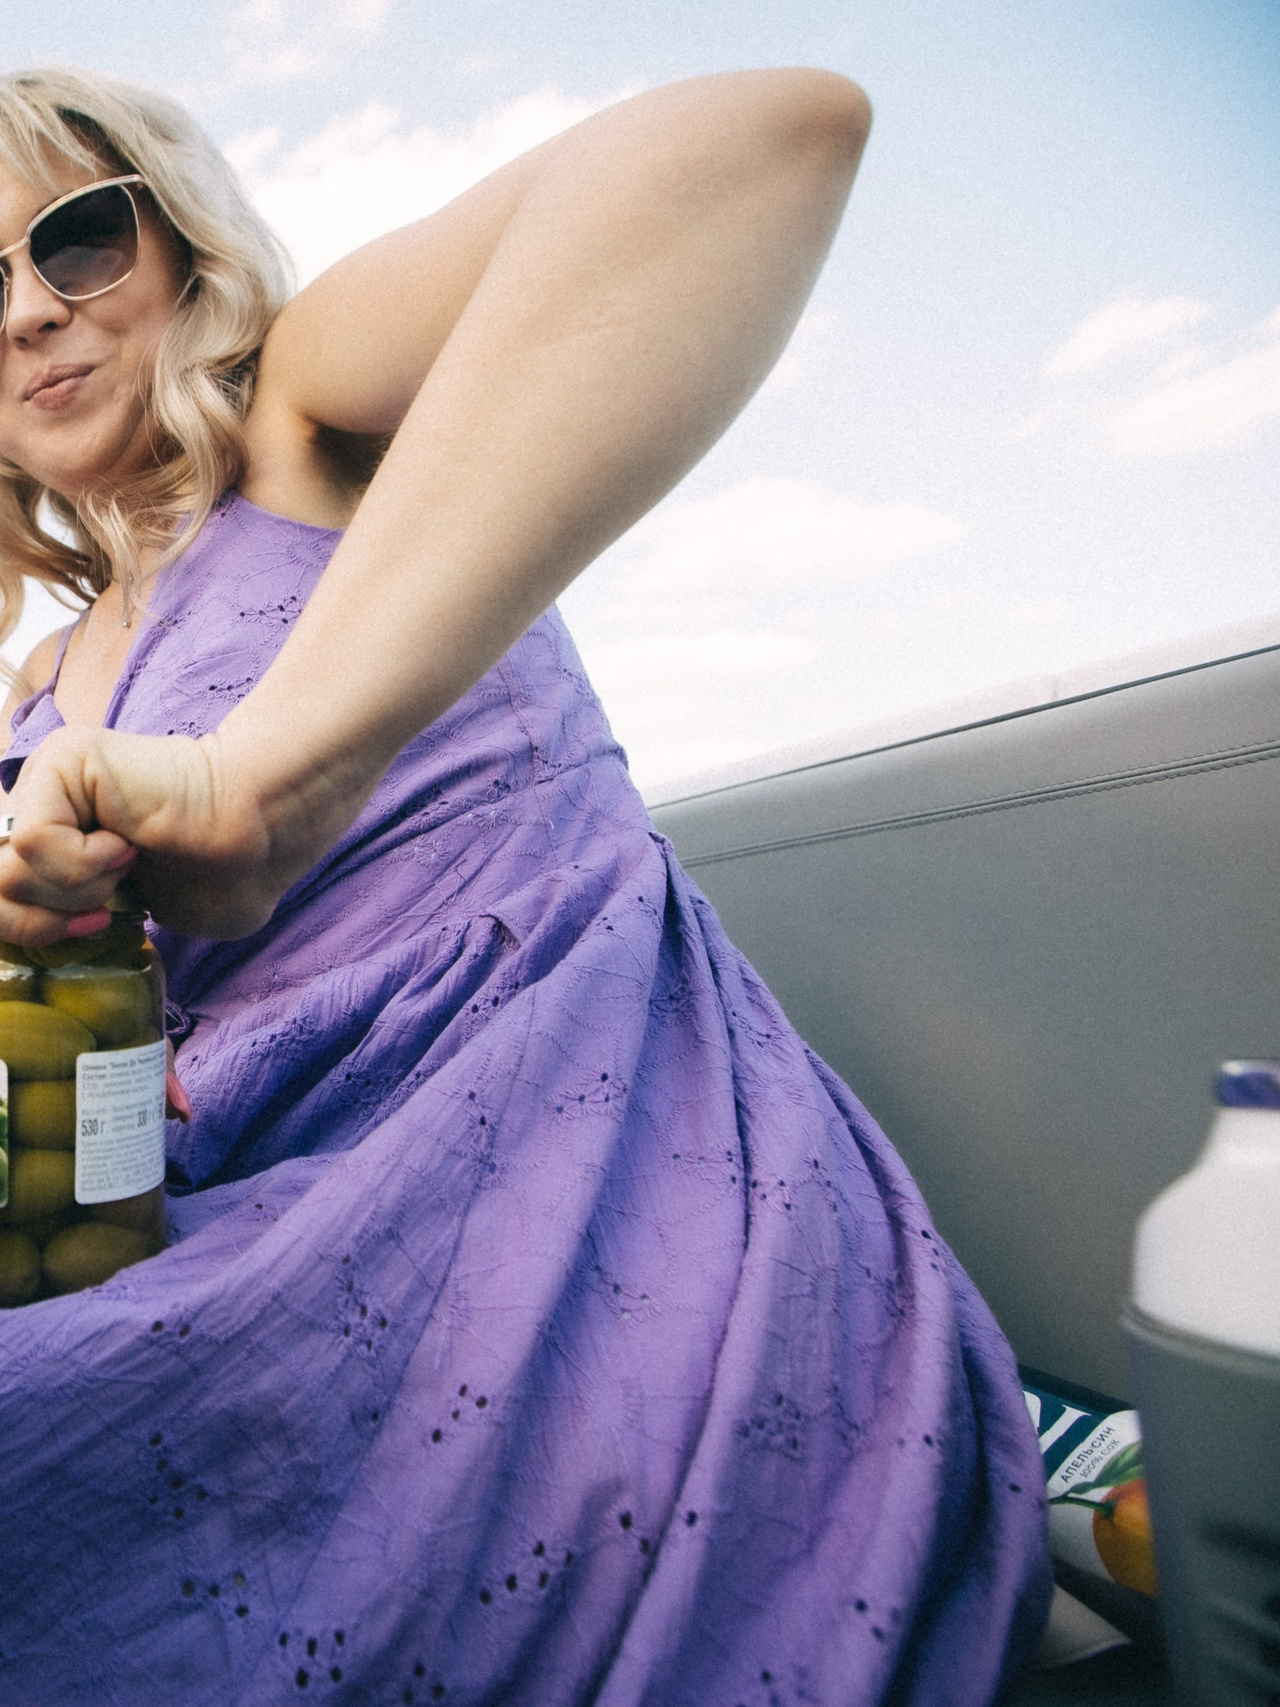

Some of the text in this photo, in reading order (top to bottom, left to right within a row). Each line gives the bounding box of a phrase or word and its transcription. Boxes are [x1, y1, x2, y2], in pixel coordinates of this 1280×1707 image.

[81, 1118, 99, 1137] 530
[1061, 1426, 1115, 1483] АПЕЛЬСИН
[1080, 1456, 1104, 1479] 100%
